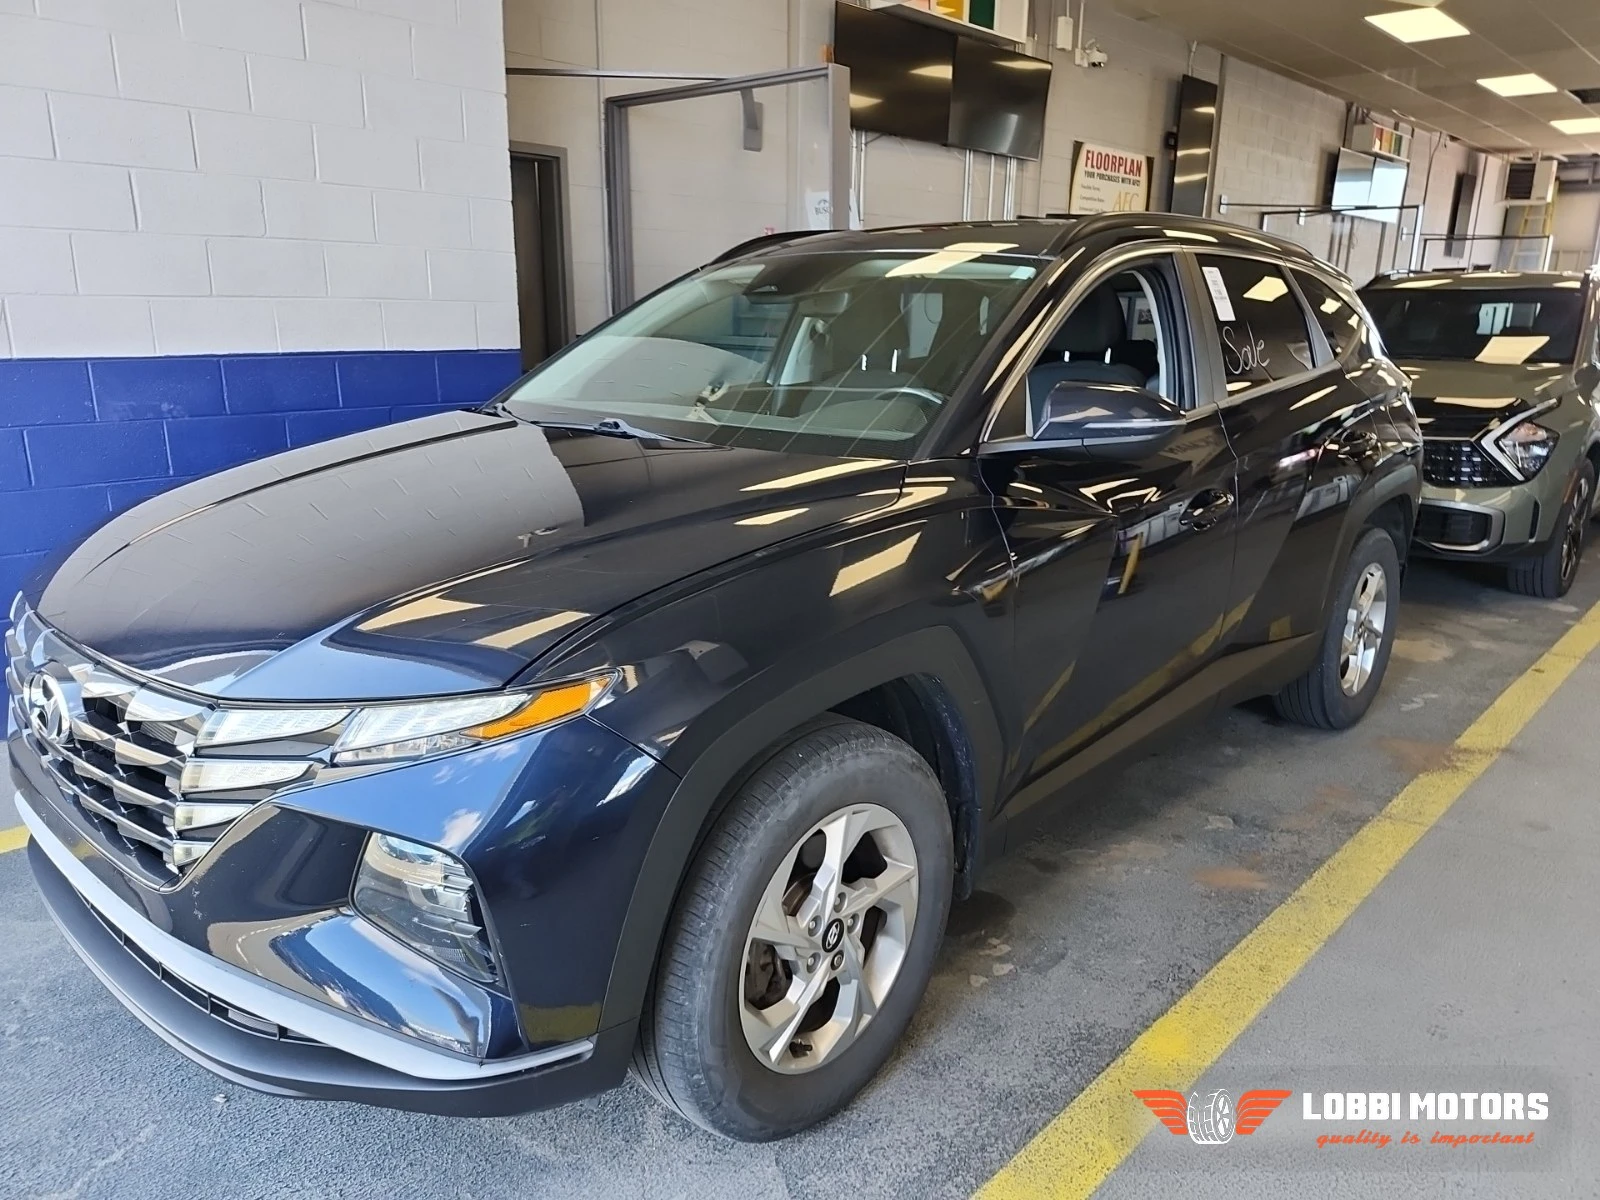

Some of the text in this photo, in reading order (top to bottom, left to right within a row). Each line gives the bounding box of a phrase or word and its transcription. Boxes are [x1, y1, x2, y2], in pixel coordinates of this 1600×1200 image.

[1084, 149, 1143, 178] FLOORPLAN
[1096, 172, 1120, 184] PURCHASES
[1222, 320, 1270, 375] Sale
